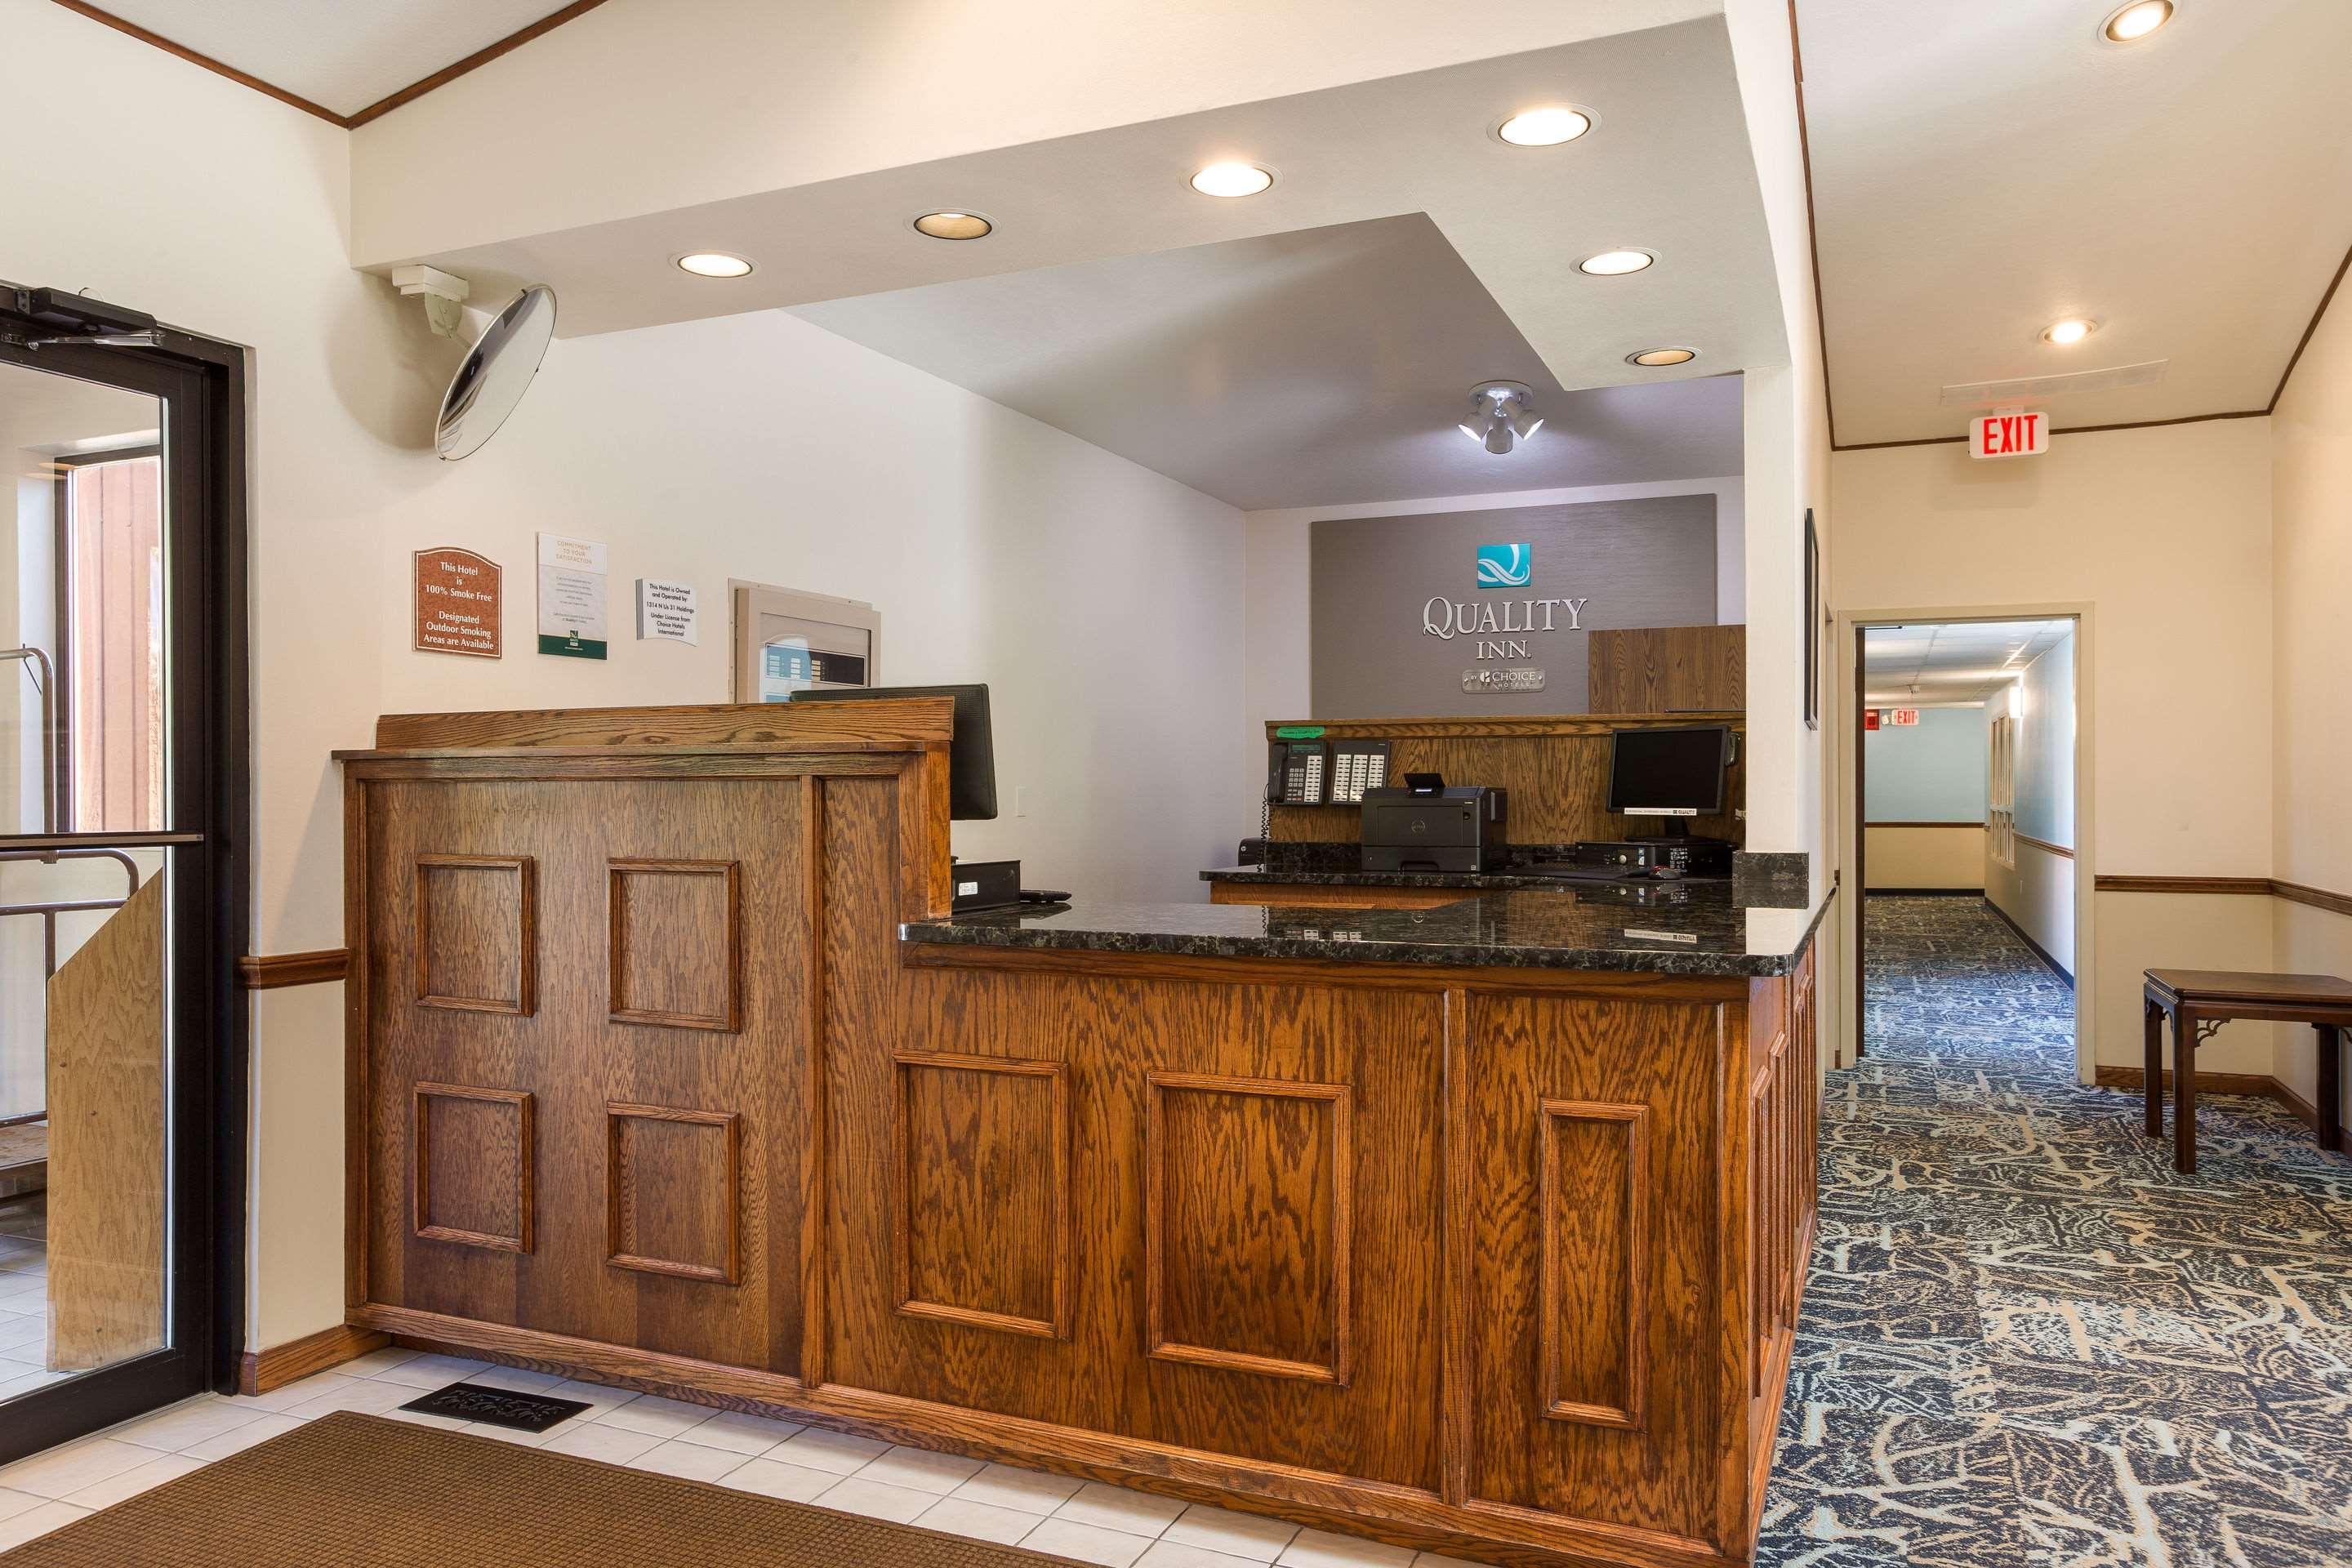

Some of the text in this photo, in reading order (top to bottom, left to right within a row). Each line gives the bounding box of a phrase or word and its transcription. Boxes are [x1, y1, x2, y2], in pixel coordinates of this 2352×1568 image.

[1984, 415, 2038, 454] EXIT
[440, 562, 478, 576] This Hotel
[457, 577, 463, 585] is
[426, 584, 492, 602] 100% Smoke Free
[661, 593, 681, 601] Operated
[439, 610, 479, 624] Designated
[676, 606, 694, 614] Holdings
[1423, 596, 1588, 640] QUALITY
[426, 621, 492, 640] Outdoor Smoking
[657, 629, 684, 637] International
[424, 634, 494, 650] Areas are Available
[1492, 671, 1535, 681] CHOICE
[1897, 710, 1916, 724] EXIT
